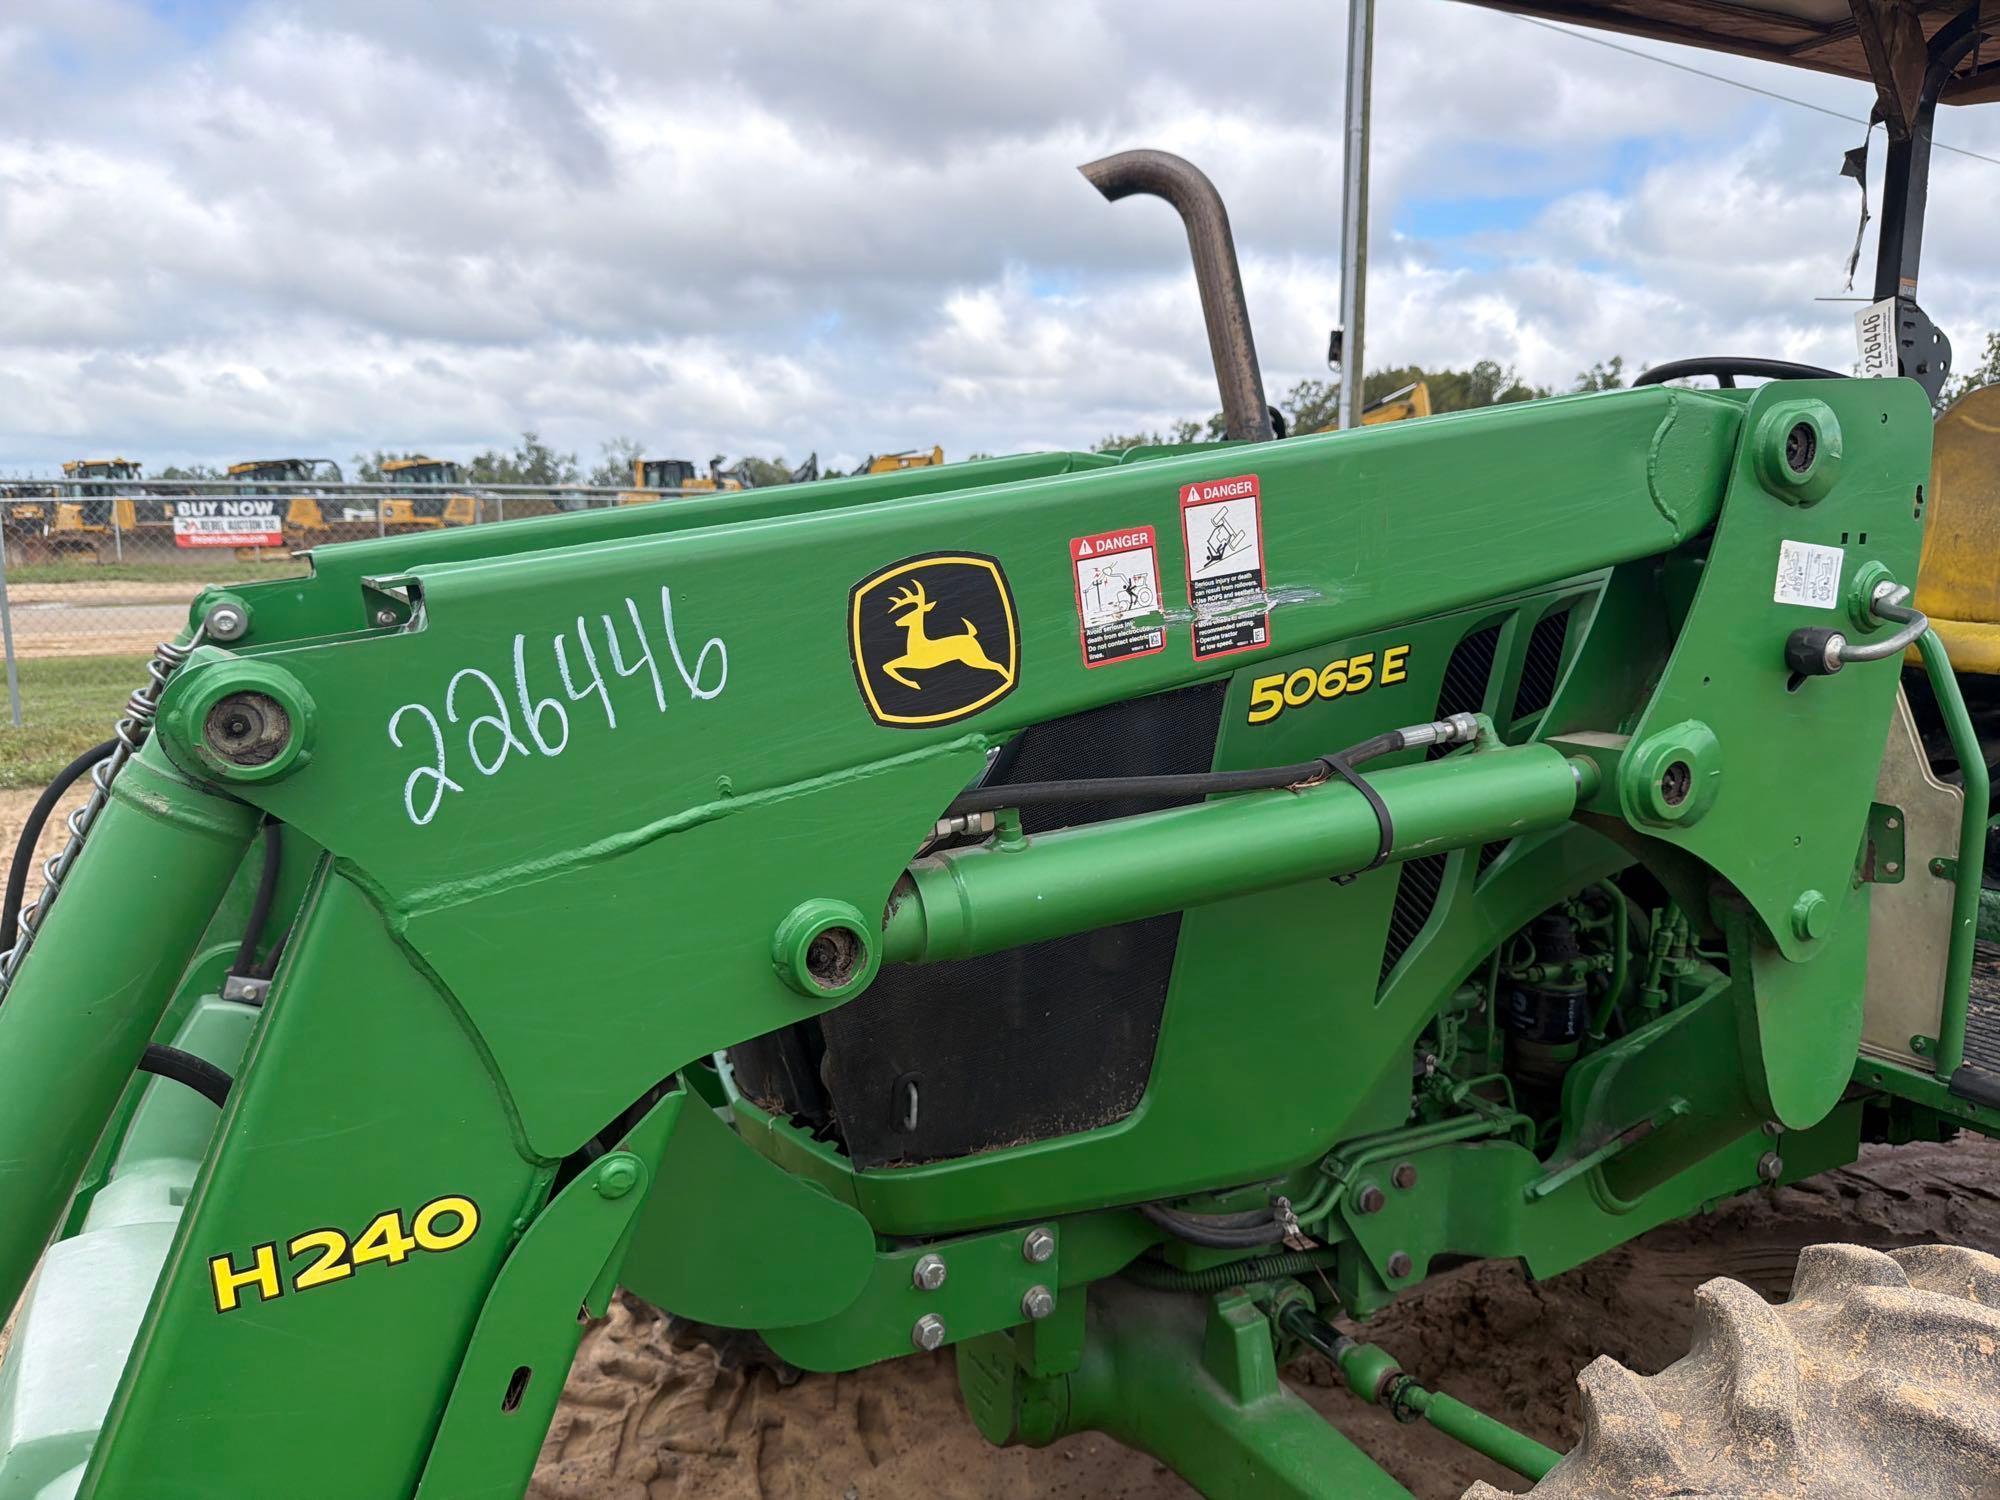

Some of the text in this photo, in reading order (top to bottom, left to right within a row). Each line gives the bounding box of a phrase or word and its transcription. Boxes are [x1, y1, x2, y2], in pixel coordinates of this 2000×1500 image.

[1863, 313, 1883, 373] 226446
[1203, 481, 1253, 500] DANGER
[177, 501, 274, 516] BUY NOW
[1096, 532, 1148, 552] DANGER
[1195, 580, 1215, 588] Serious
[1216, 577, 1230, 585] injury
[1238, 572, 1252, 580] death
[1208, 594, 1222, 602] ROPS
[1234, 588, 1254, 596] seatbelt
[1086, 628, 1102, 636] Avoid
[1103, 623, 1124, 632] serious
[1199, 624, 1235, 636] recommended
[1087, 636, 1103, 644] death
[1088, 644, 1096, 652] Do
[1108, 640, 1128, 648] contact
[1129, 634, 1149, 643] electric
[1200, 634, 1220, 644] Operate
[1216, 639, 1233, 648] speed.
[1088, 652, 1104, 660] lines.
[388, 585, 728, 825] 226446
